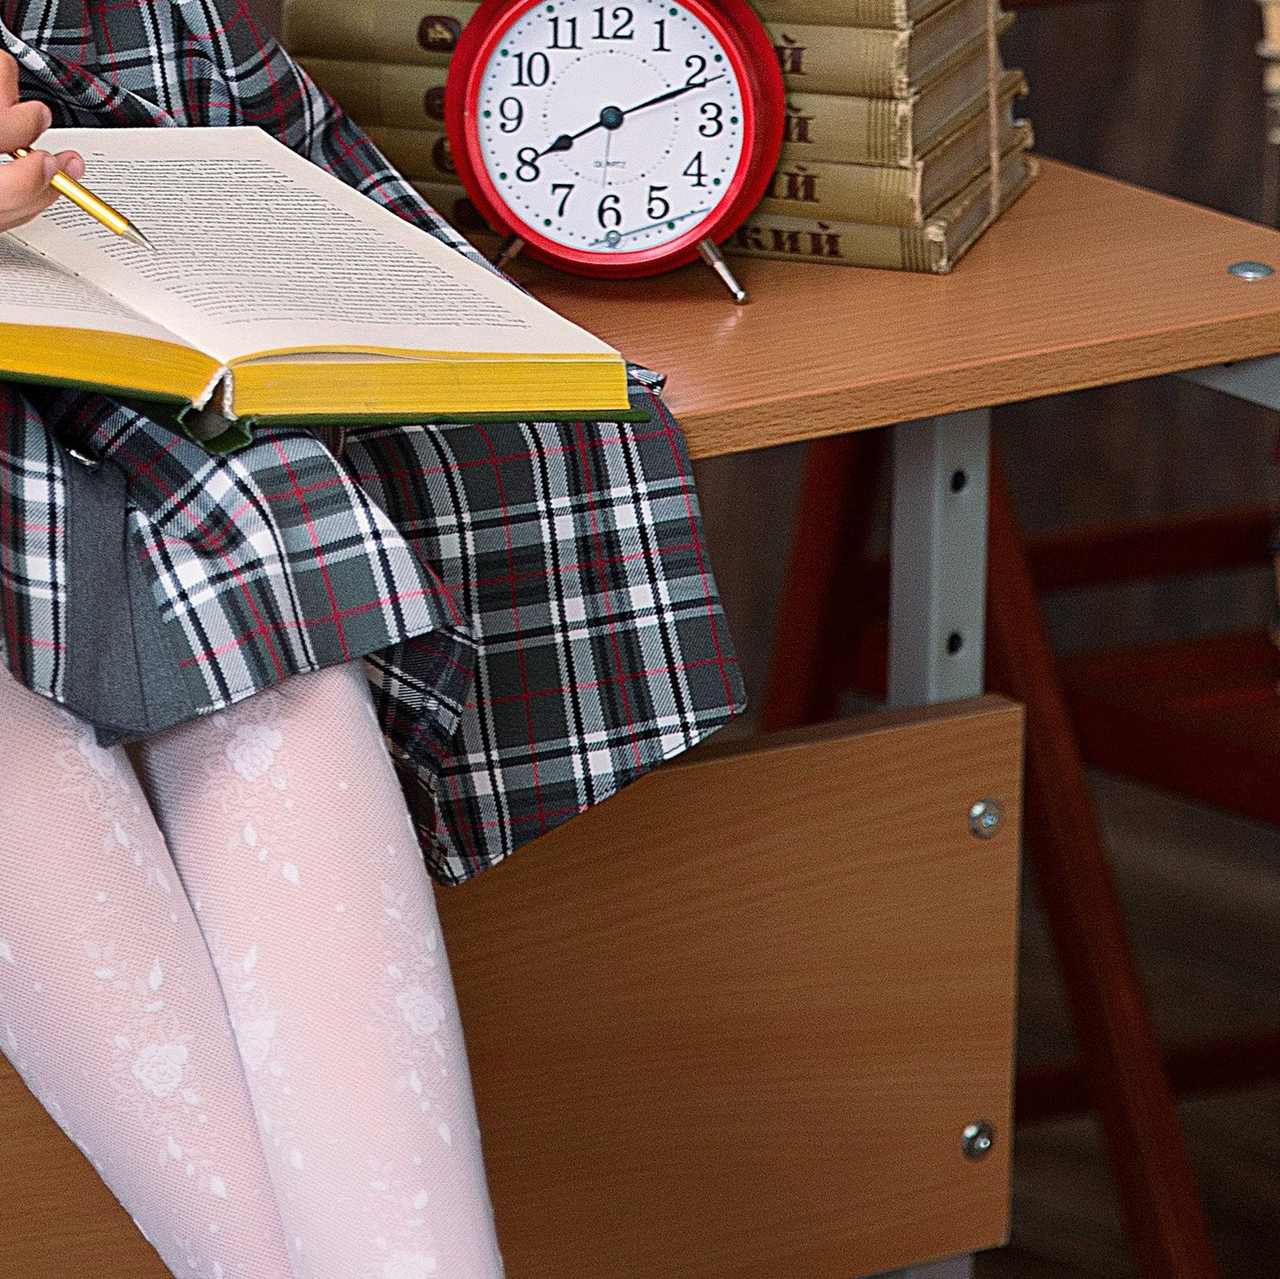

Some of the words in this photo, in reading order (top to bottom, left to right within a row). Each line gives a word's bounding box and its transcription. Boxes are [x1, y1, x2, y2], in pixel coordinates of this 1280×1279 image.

[547, 15, 582, 50] 11
[593, 7, 634, 40] 12
[653, 19, 671, 51] 1
[510, 52, 550, 87] 10
[685, 55, 708, 88] 2
[499, 96, 523, 133] 9
[699, 102, 723, 137] 3
[516, 147, 540, 182] 8
[683, 151, 708, 187] 4
[550, 183, 576, 216] 7
[597, 195, 622, 229] 6
[647, 186, 669, 219] 5
